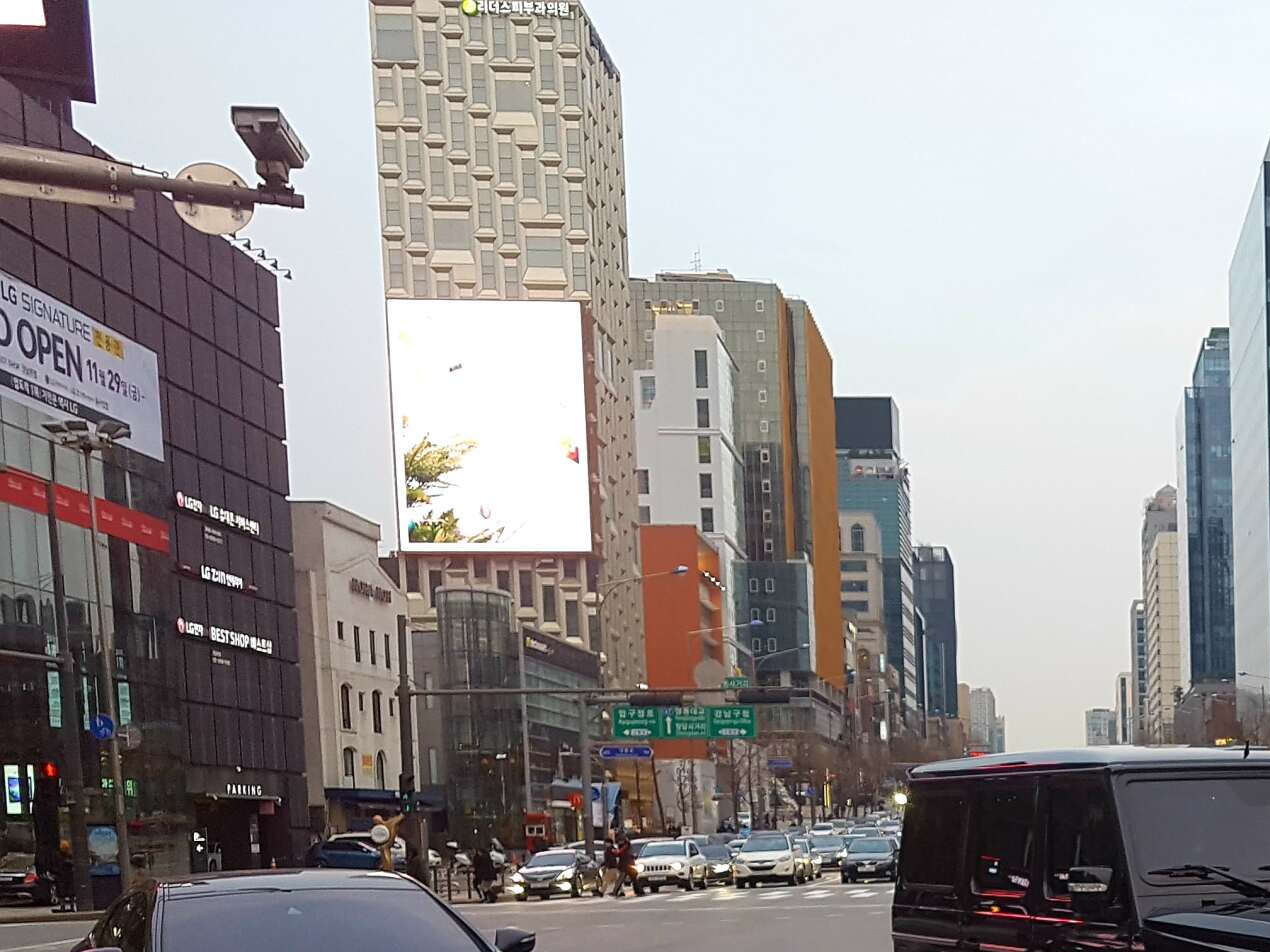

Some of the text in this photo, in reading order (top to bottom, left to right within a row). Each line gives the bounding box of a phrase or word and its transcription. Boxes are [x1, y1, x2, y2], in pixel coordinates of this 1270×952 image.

[477, 1, 570, 16] 리더스피부과의원
[1, 280, 17, 305] LG
[21, 292, 92, 342] SIGNATURE
[17, 318, 83, 383] OPEN
[210, 505, 219, 520] LG
[201, 565, 211, 580] LG
[210, 626, 230, 644] BEST
[230, 631, 249, 648] SHOP
[226, 783, 262, 796] PARKING
